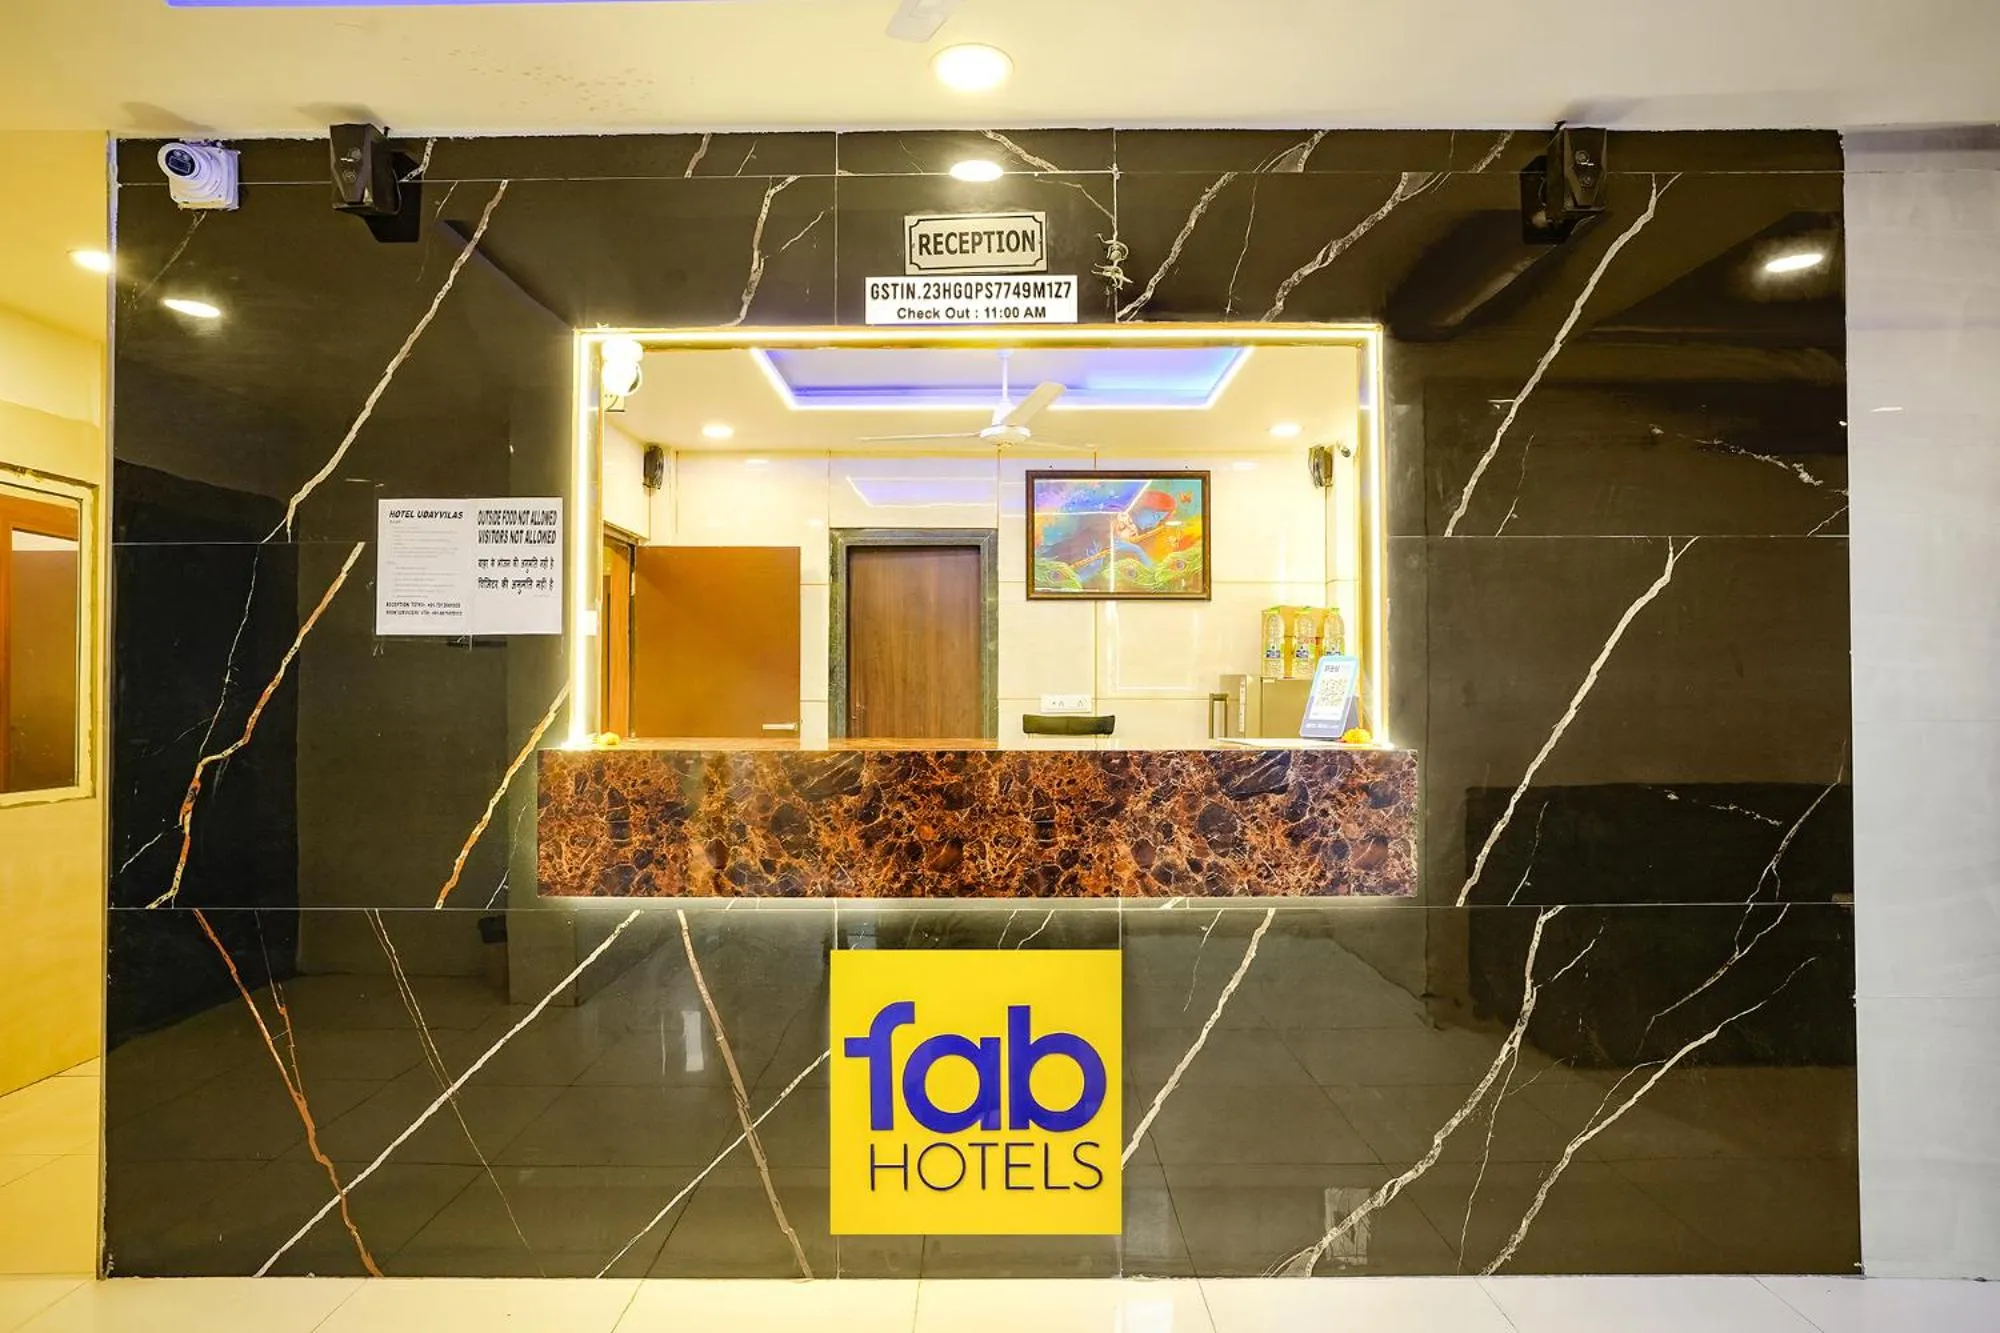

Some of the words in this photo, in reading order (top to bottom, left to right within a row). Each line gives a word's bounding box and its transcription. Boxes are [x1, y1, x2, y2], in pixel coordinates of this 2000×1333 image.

[918, 229, 1036, 256] RECEPTION
[897, 307, 940, 320] Check
[945, 307, 970, 320] Out
[984, 307, 1020, 319] 11:00
[1023, 306, 1046, 319] AM
[389, 510, 415, 519] HOTEL
[477, 510, 502, 526] OUTSIDE
[502, 510, 518, 526] FOOD
[518, 510, 530, 526] NOT
[531, 510, 558, 526] ALLOWED
[478, 529, 509, 545] VISITORS
[510, 529, 524, 545] NOT
[524, 529, 557, 545] ALLOWED
[844, 1000, 1107, 1134] fab
[869, 1141, 1105, 1192] HOTELS
